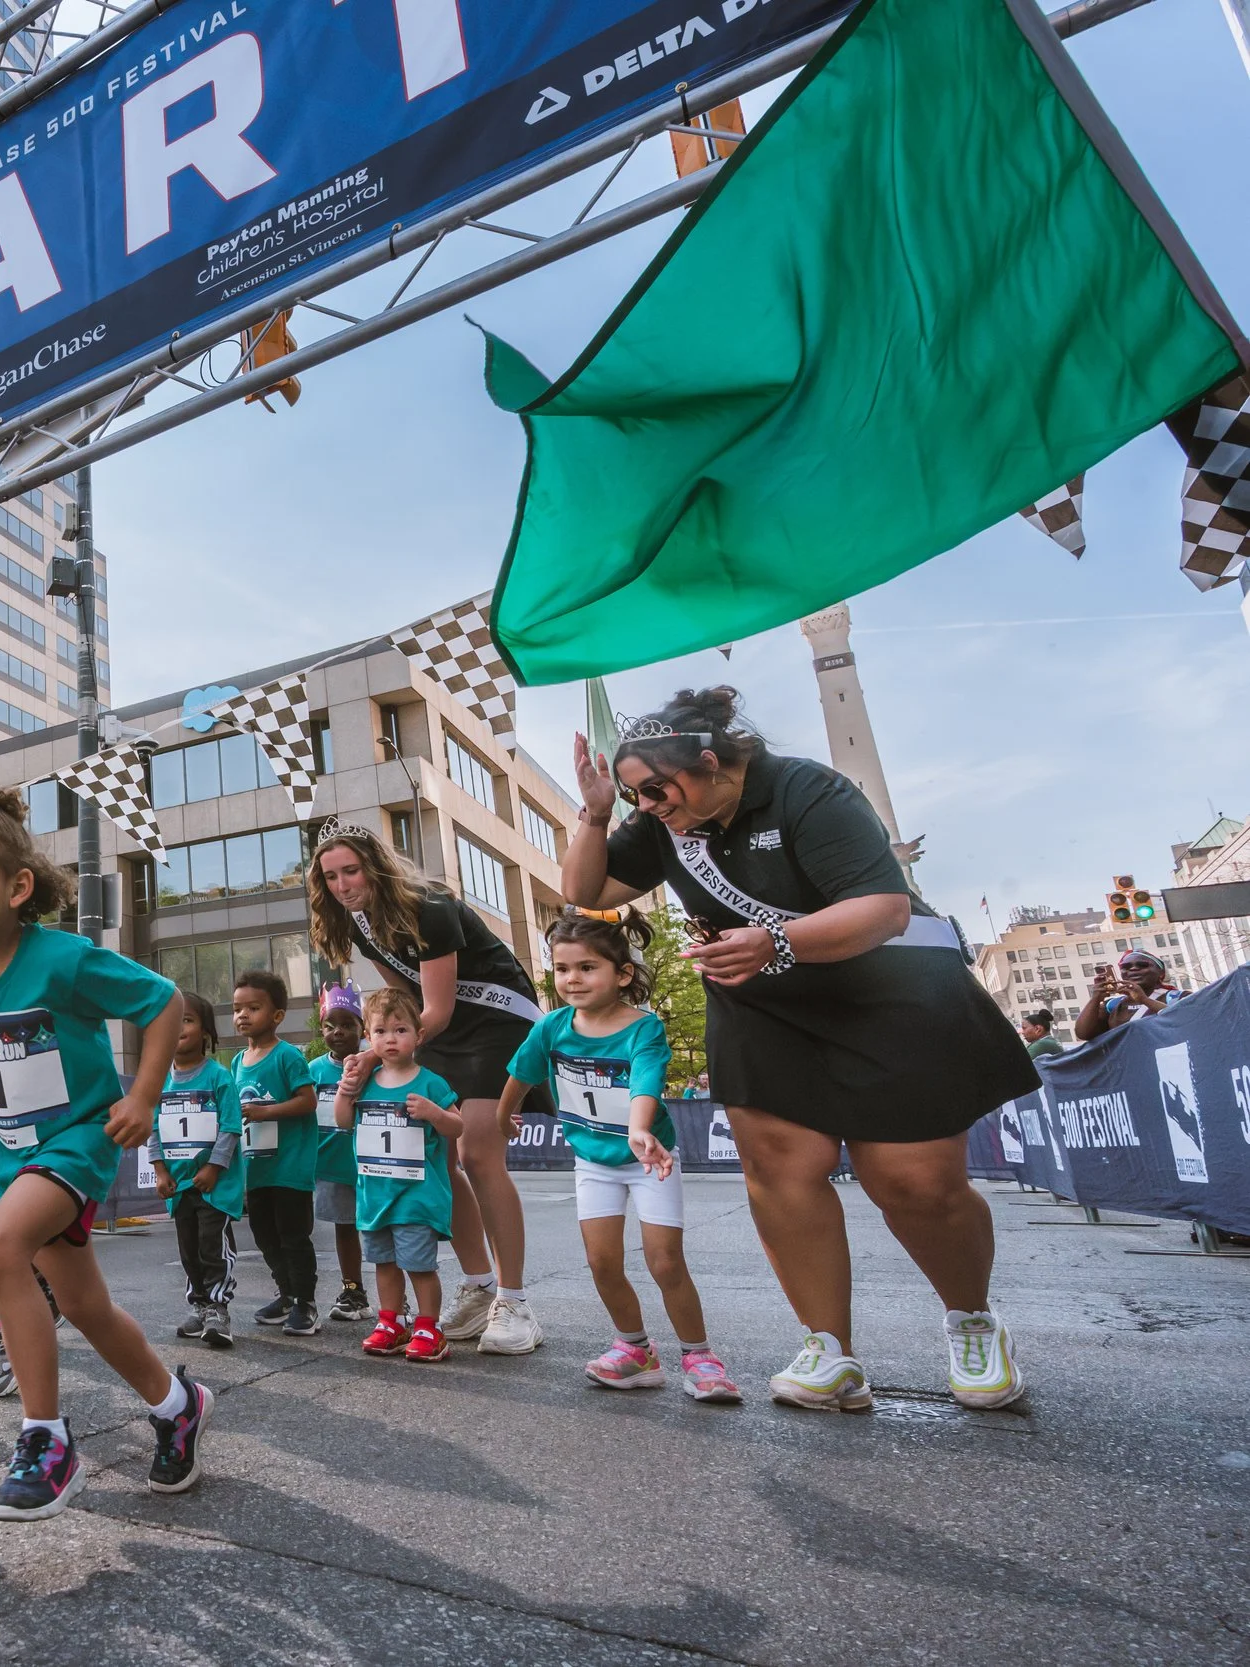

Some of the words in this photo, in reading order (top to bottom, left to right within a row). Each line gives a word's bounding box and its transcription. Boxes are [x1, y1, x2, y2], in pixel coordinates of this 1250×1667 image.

[583, 15, 716, 97] DELTA
[46, 95, 94, 139] 500
[107, 0, 247, 99] FESTIVAL
[207, 217, 273, 261] Peyton
[277, 166, 369, 224] Manning
[197, 229, 285, 284] Children's
[293, 176, 384, 234] Hospital
[220, 262, 286, 301] Ascension
[288, 253, 307, 267] St.
[307, 222, 363, 257] Vincent
[682, 840, 700, 862] 500
[355, 914, 370, 935] 500
[485, 991, 512, 1006] 2025
[585, 1071, 611, 1089] RUN
[583, 1091, 597, 1117] 1
[178, 1117, 188, 1138] 1
[386, 1112, 408, 1127] RUN
[1058, 1100, 1083, 1149] 500
[1080, 1091, 1141, 1149] FESTIVAL
[244, 1127, 251, 1147] 1
[381, 1130, 392, 1154] 1
[710, 1150, 723, 1158] 500
